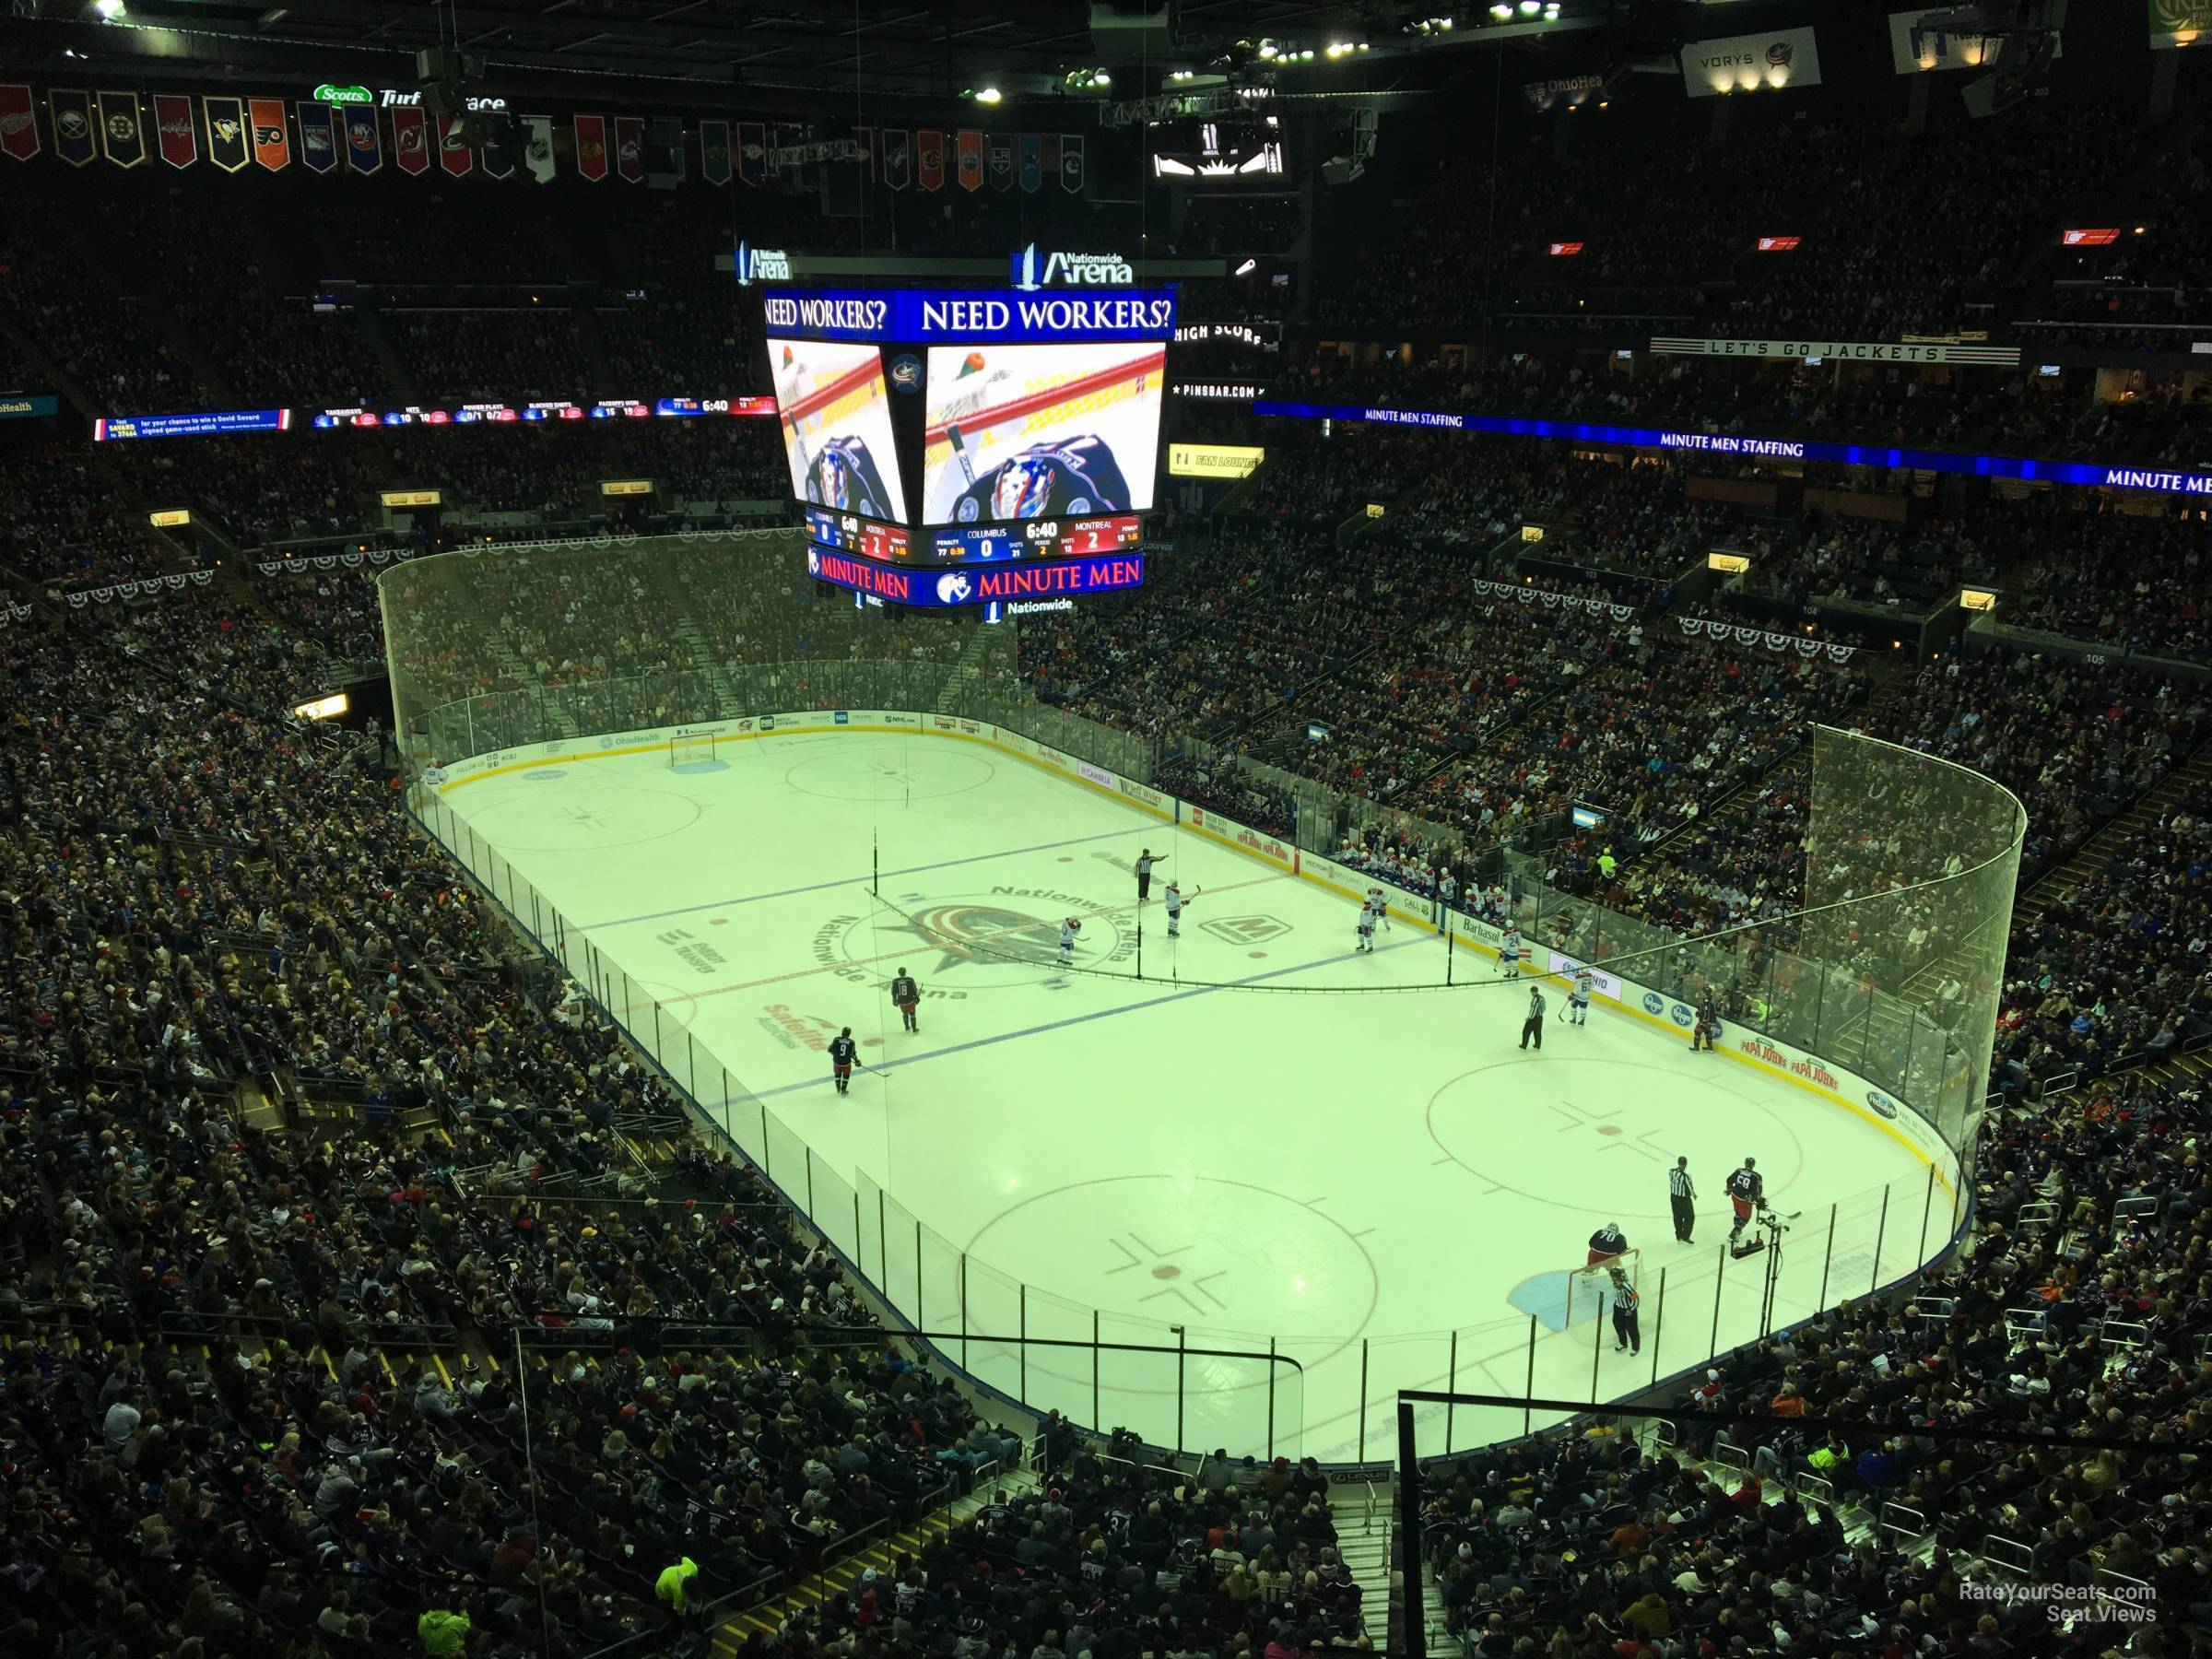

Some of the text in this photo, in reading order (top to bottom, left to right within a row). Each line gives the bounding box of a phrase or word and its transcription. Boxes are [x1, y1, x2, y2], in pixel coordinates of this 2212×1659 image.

[1700, 53, 1754, 68] VORYS
[323, 88, 364, 101] Scotts
[380, 89, 505, 111] Turf ace
[748, 249, 790, 280] Arena
[1067, 253, 1123, 265] Nationwide
[1042, 253, 1134, 284] Arena
[764, 299, 887, 330] NEED WORKERS?
[922, 300, 1171, 330] NEED WORKERS?
[1174, 325, 1208, 342] HIGH
[1711, 339, 1939, 360] LET'S GO JACKETS
[702, 400, 728, 412] 6:40
[400, 414, 430, 422] 10 10
[467, 411, 502, 420] 0/1 0/2
[1365, 409, 1463, 428] MINUTE MEN STAFFING
[164, 426, 199, 434] game-used
[1661, 433, 1804, 457] MINUTE MEN STAFFING
[1195, 454, 1218, 466] FAN
[2106, 469, 2182, 491] MINUTE
[821, 524, 828, 540] 0
[967, 527, 1006, 538] COLUMBUS
[1026, 522, 1057, 539] 6:40
[1075, 520, 1112, 531] MONTREAL
[873, 536, 880, 554] 2
[1088, 532, 1099, 548] 2
[937, 548, 947, 557] 77
[980, 540, 993, 558] 0
[1012, 549, 1020, 558] 21
[1040, 546, 1047, 555] 2
[821, 555, 909, 599] MINUTE MEN
[978, 559, 1141, 597] MINUTE MEN
[1007, 598, 1074, 615] Nationwide
[2086, 653, 2105, 665] 105
[615, 733, 661, 746] OhioHealth
[1086, 768, 1111, 785] CAMBRIA
[1130, 782, 1162, 805] Jeff Wyler
[1305, 859, 1327, 872] VECTOR
[991, 886, 1132, 927] Nationwide
[1404, 898, 1420, 910] CALL
[1464, 918, 1500, 943] Barbasol
[814, 915, 865, 982] Nationwide
[1108, 928, 1139, 964] Arena
[1509, 936, 1520, 947] 24
[675, 946, 716, 974] TRANSFER
[692, 942, 728, 964] ENERGY
[898, 984, 908, 996] 18
[1593, 976, 1607, 990] HIO
[1644, 995, 1663, 1013] Kroger
[1673, 1006, 1691, 1024] Kroger
[763, 1004, 828, 1051] Safelite
[840, 1043, 846, 1056] 9
[1741, 1041, 1760, 1057] PAPA
[1792, 1061, 1811, 1078] PAPA
[1869, 1094, 1897, 1116] Pedialyte
[1736, 1174, 1751, 1189] 58
[1599, 1230, 1616, 1242] 70
